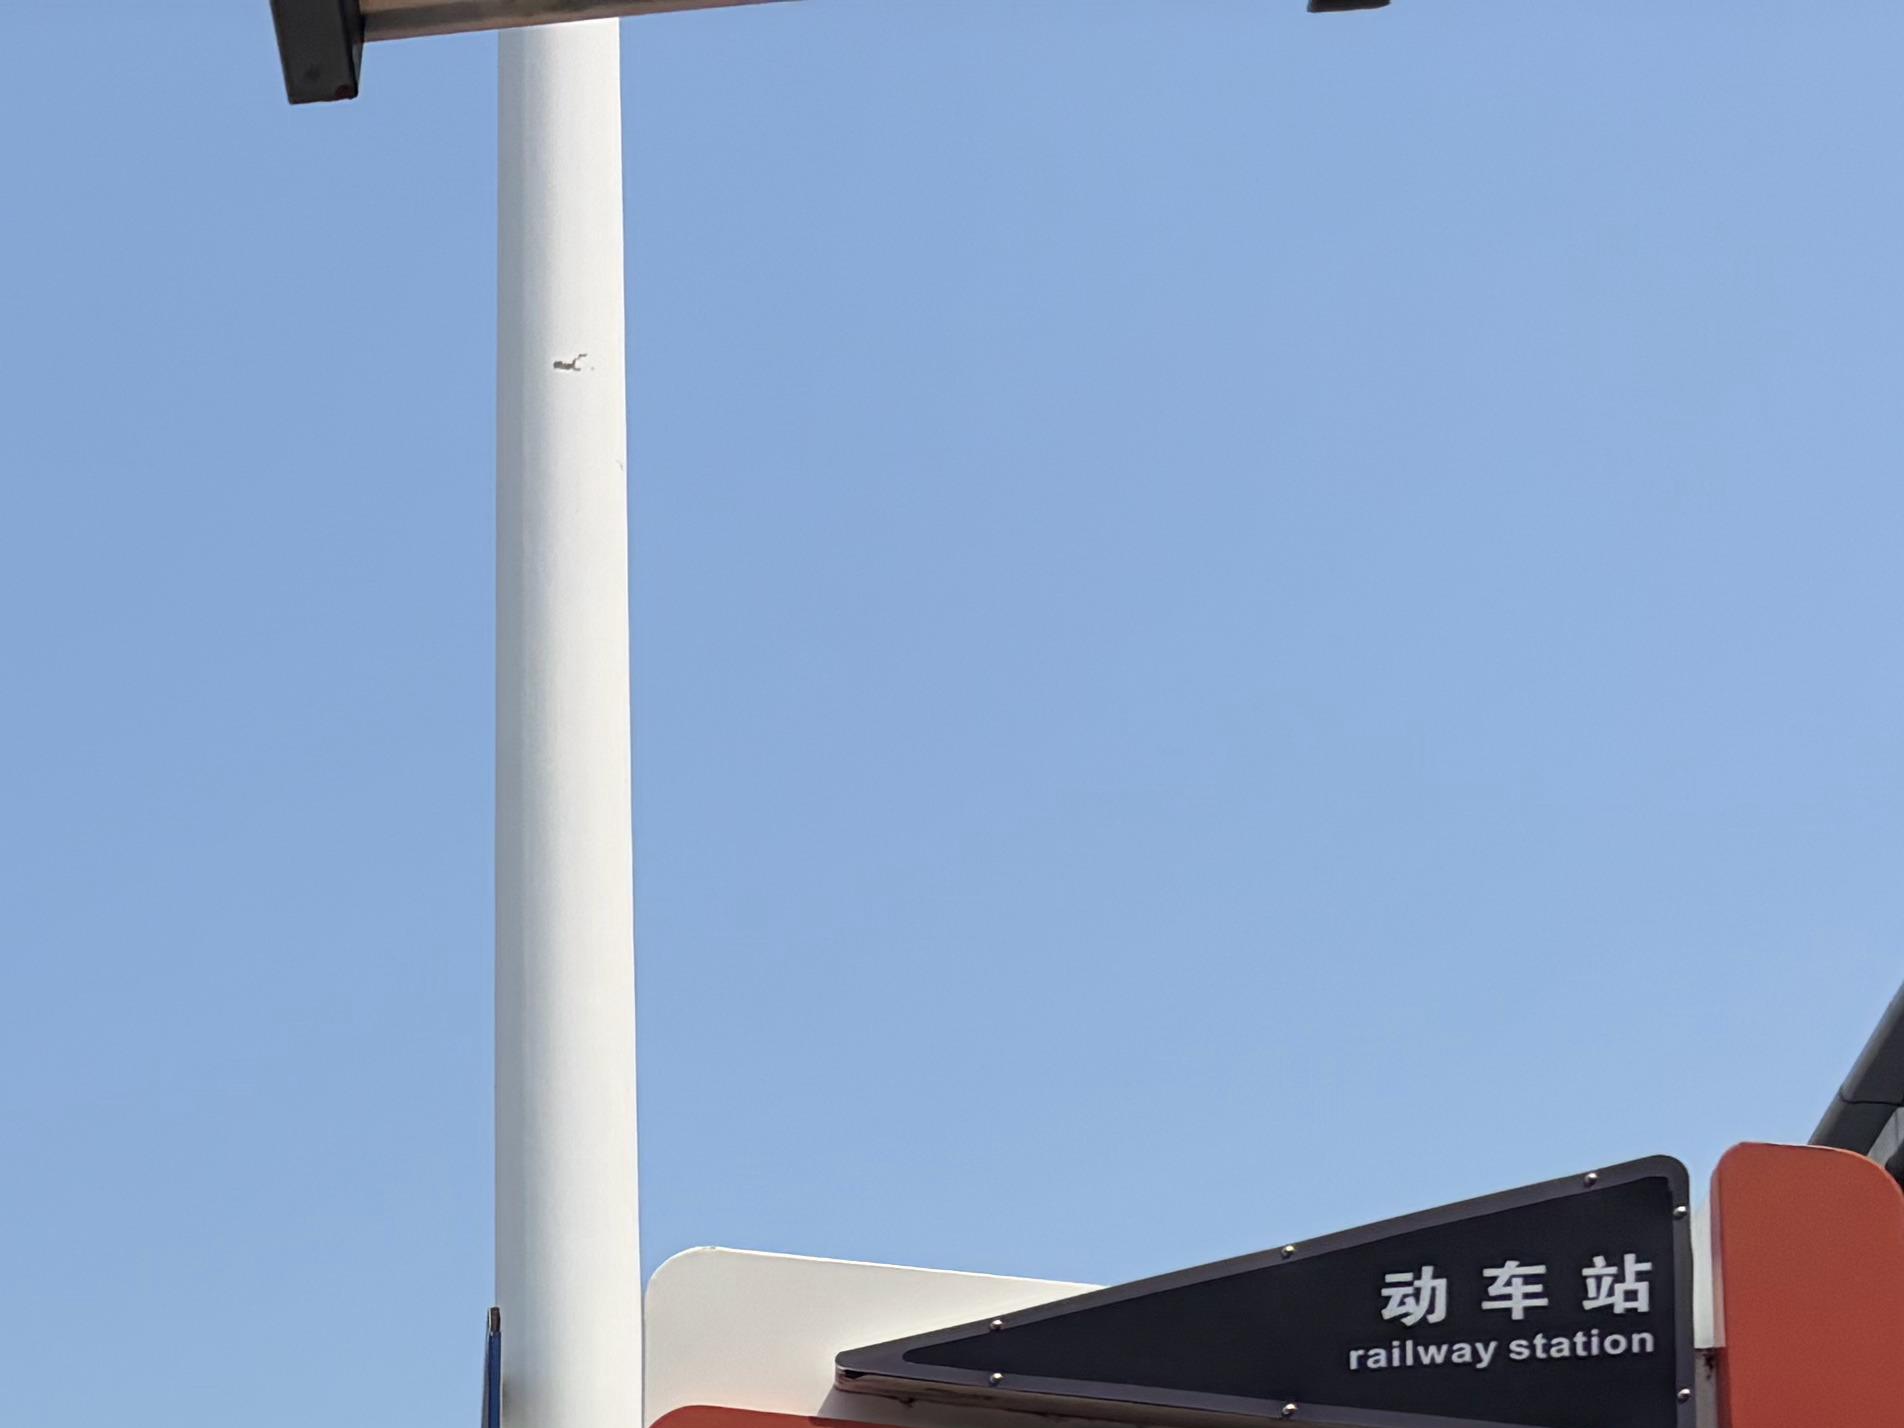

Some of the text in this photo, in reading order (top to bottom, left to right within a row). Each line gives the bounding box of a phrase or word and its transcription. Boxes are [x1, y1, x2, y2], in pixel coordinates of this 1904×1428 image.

[1381, 1254, 1652, 1332] 动车站
[1350, 1329, 1653, 1369] railway station
